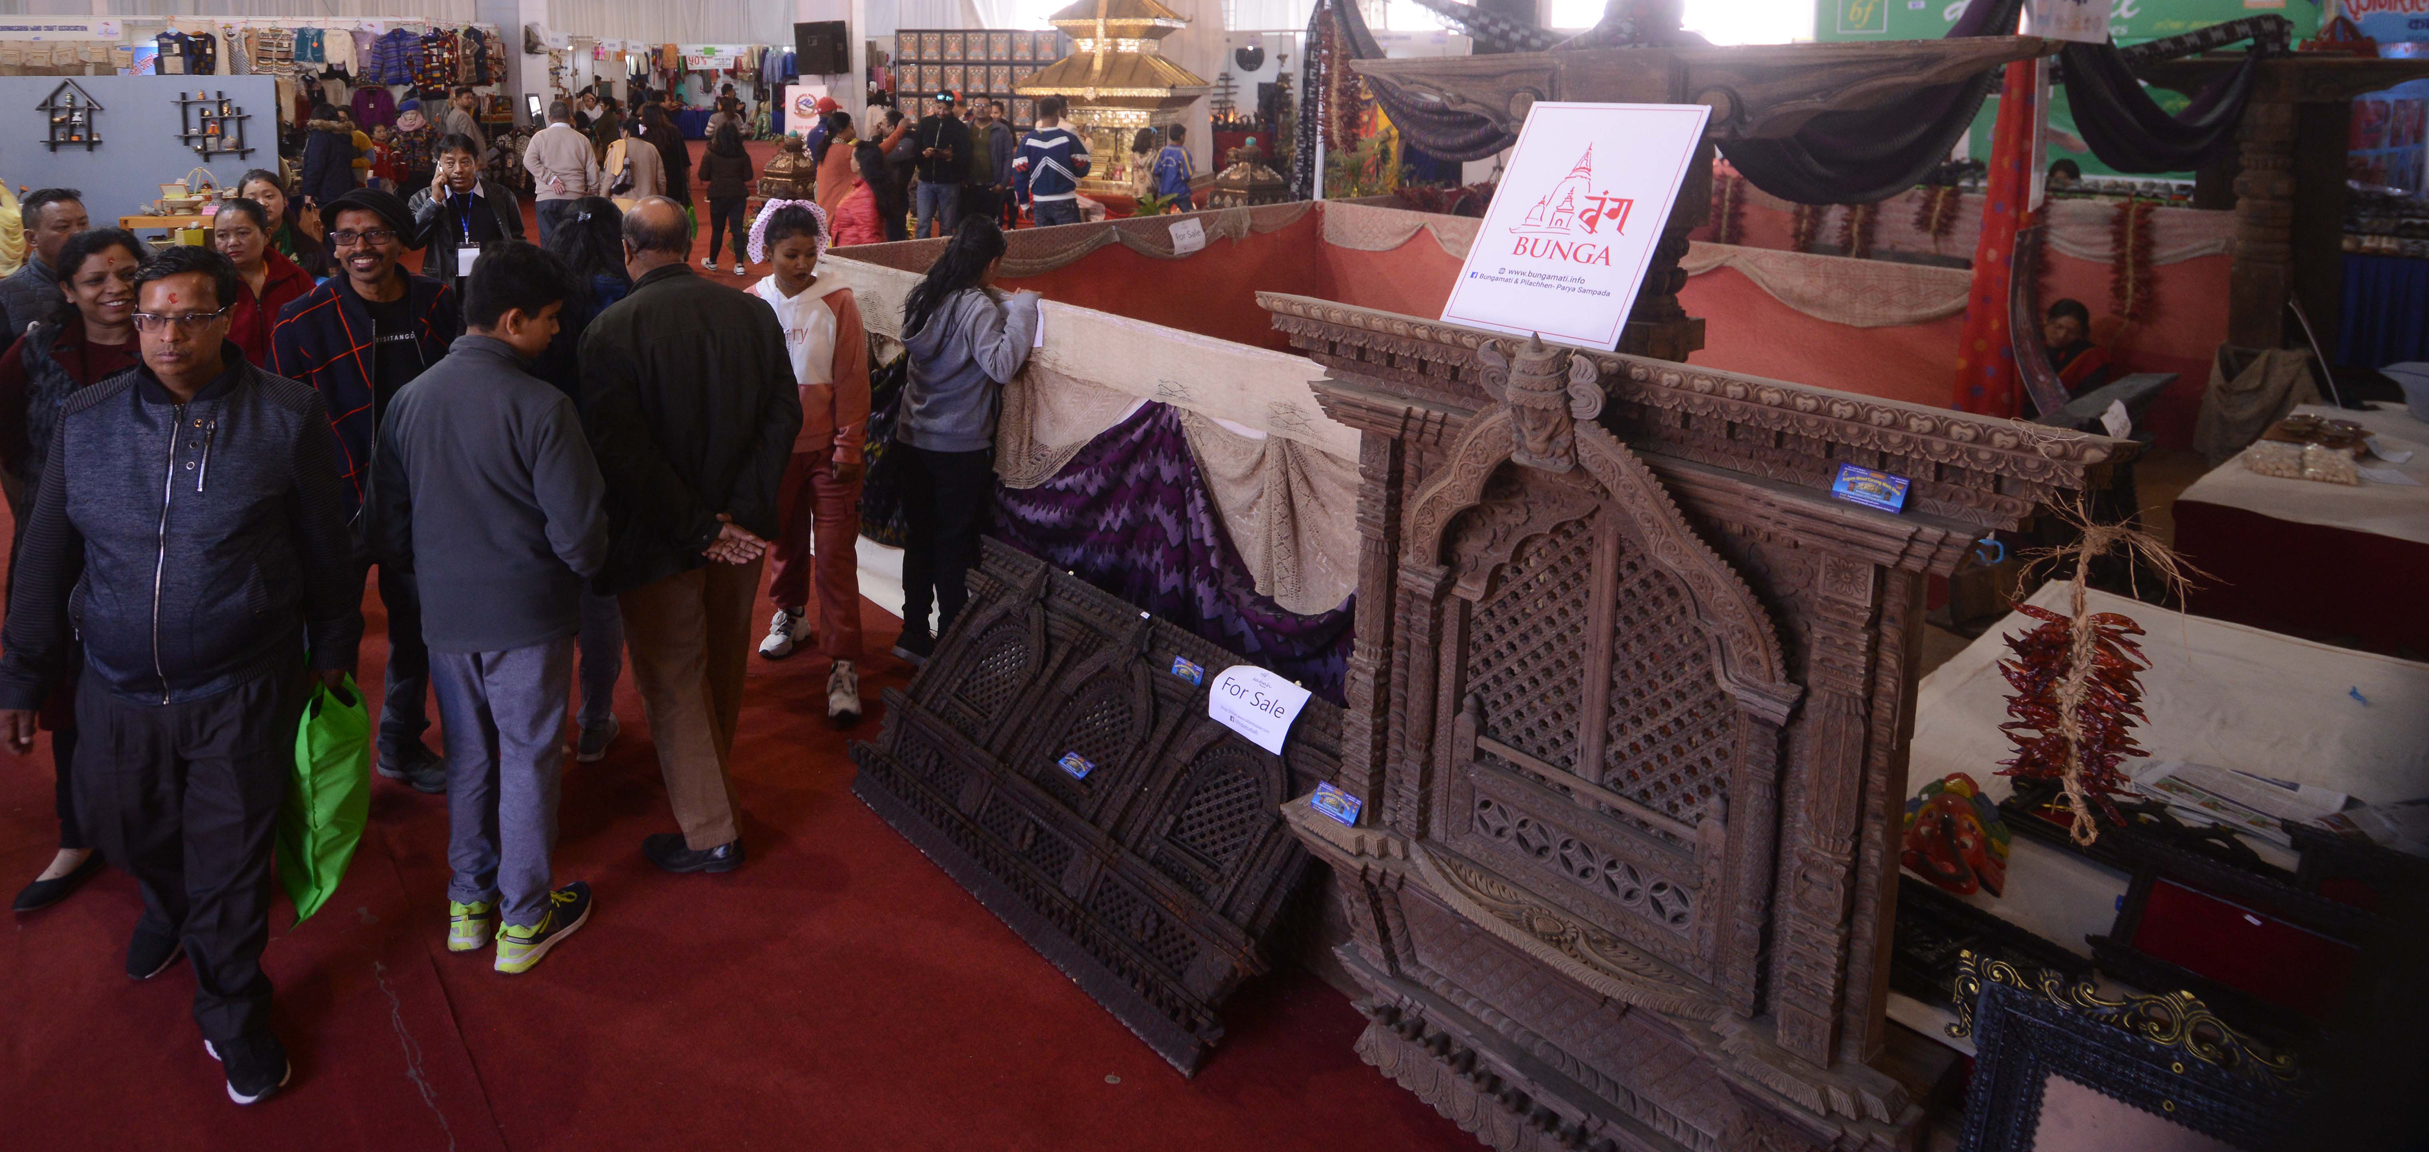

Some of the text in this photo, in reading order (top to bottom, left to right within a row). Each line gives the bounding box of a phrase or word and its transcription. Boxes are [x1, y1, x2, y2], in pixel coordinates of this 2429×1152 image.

[1187, 228, 1201, 239] Sale
[1512, 237, 1611, 266] BUNGA
[1479, 273, 1514, 284] Bungamati
[1556, 283, 1576, 293] Parya
[1577, 287, 1611, 297] Sampada
[1508, 268, 1586, 285] www.bungamati.info
[1221, 676, 1249, 699] For
[1250, 691, 1285, 719] Sale
